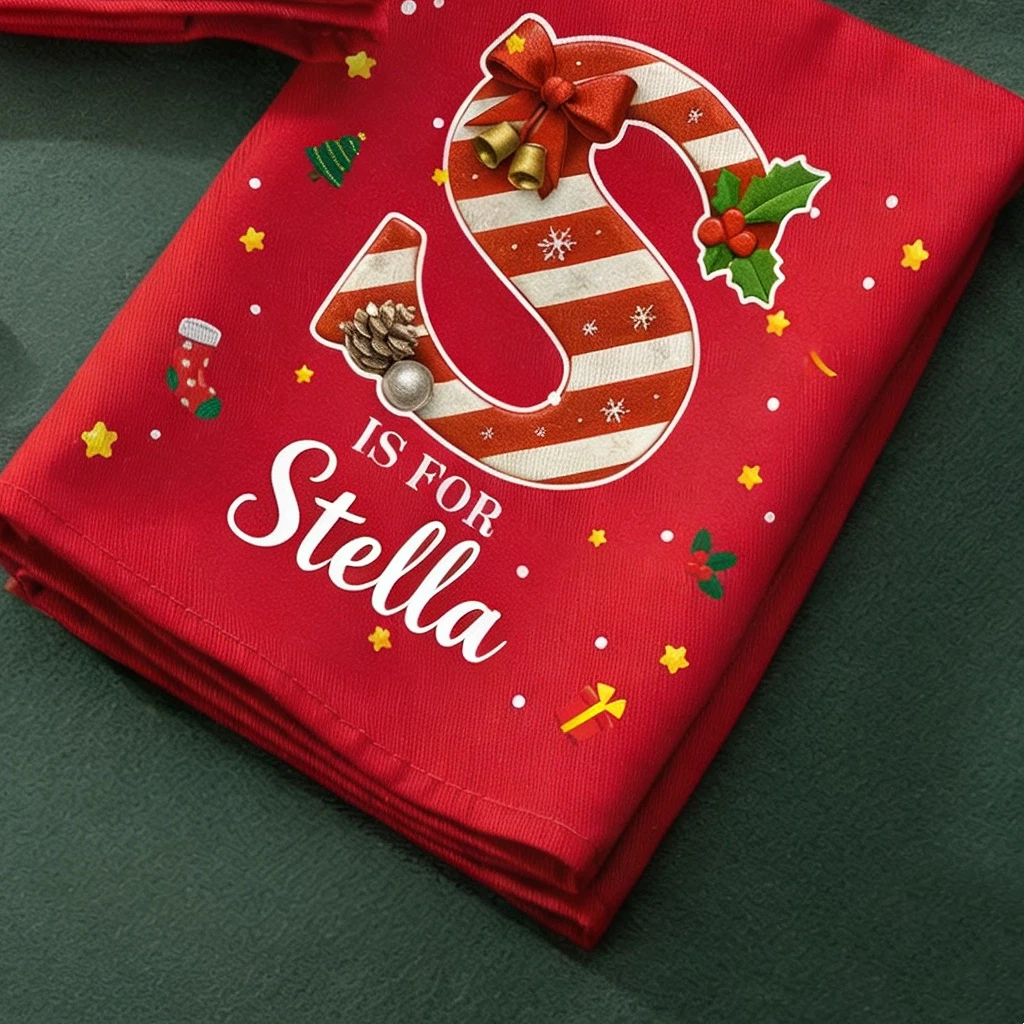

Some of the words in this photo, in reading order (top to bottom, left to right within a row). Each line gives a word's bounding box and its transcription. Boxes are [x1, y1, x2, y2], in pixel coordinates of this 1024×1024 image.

[312, 13, 831, 490] S
[226, 439, 507, 664] Stella
[351, 416, 408, 468] IS
[405, 453, 502, 538] FOR
